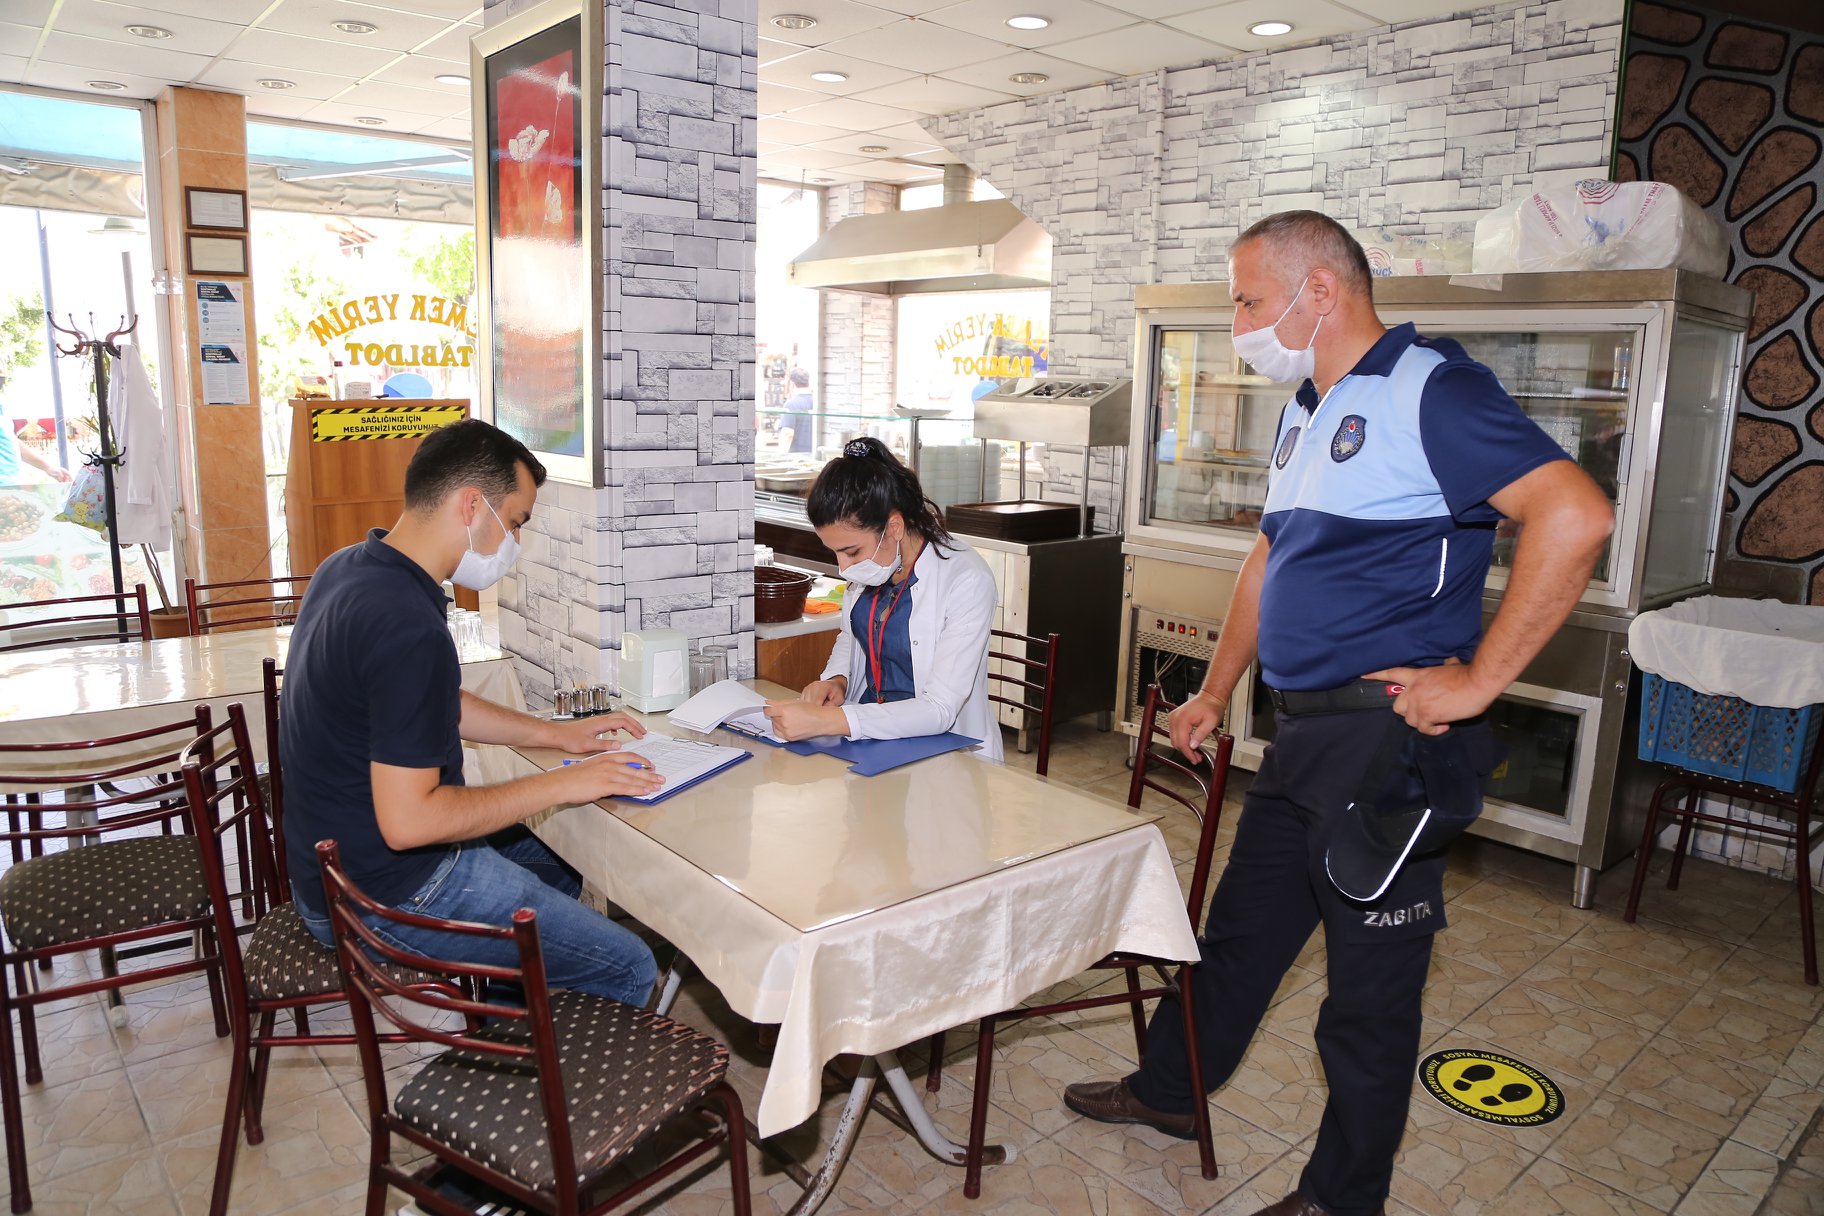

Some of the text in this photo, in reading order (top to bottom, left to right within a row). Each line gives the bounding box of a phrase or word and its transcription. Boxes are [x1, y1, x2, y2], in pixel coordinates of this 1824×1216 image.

[361, 414, 422, 424] SAĞLIĞINIZ İÇİN
[343, 424, 390, 433] MESAFENİZİ
[1363, 900, 1432, 927] ZABITA
[1442, 1051, 1479, 1061] SOSYAL
[1481, 1053, 1541, 1080] MESAFENİZİ
[1507, 1114, 1544, 1124] SOSYAL
